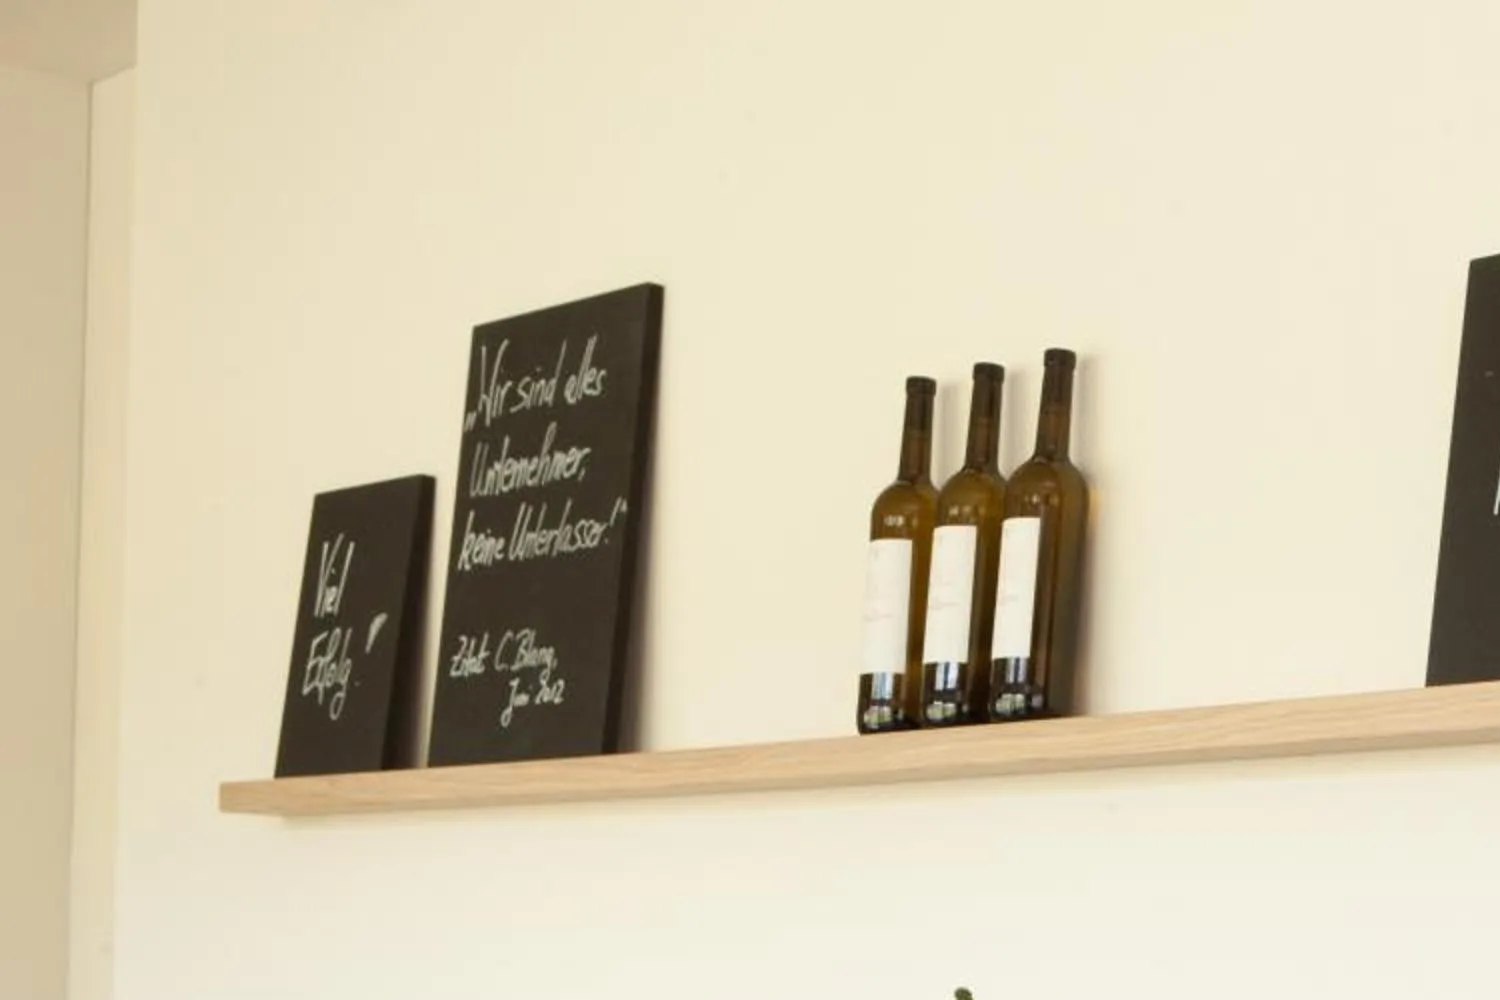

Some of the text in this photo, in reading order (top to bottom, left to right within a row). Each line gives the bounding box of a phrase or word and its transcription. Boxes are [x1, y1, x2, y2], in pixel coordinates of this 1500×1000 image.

[510, 339, 567, 414] sind
[314, 532, 355, 619] Viel
[457, 509, 506, 571] keine
